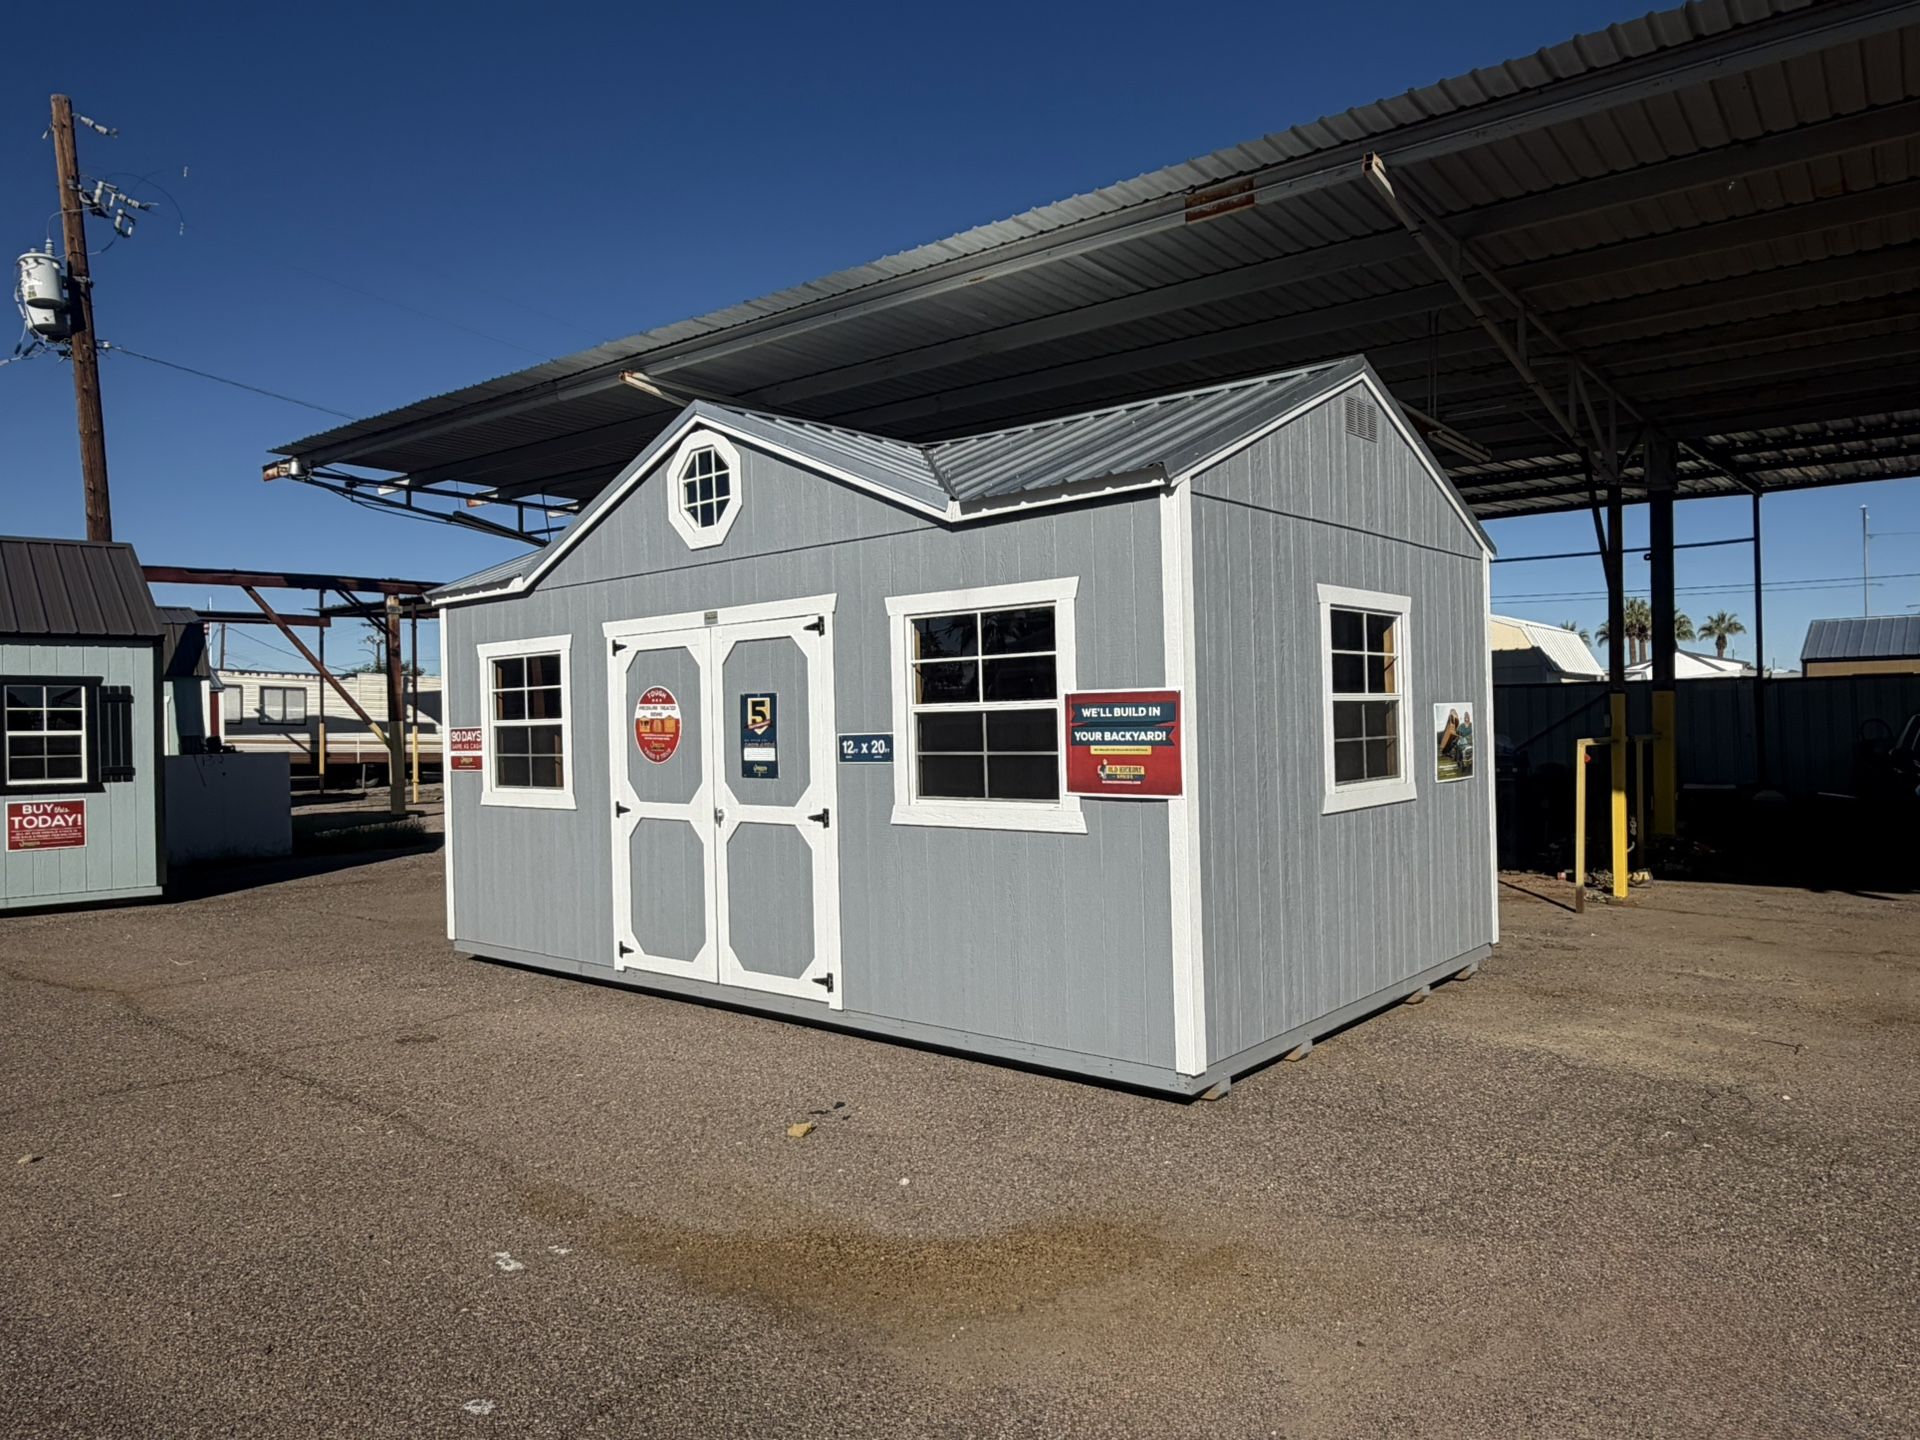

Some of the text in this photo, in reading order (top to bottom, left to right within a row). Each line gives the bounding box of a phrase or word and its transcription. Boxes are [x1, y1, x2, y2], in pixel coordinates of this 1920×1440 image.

[752, 701, 767, 724] 5
[1082, 706, 1160, 717] WE'LL BUILD IN
[451, 730, 481, 742] 90 DAYS
[1074, 731, 1166, 741] YOUR BACKYARD!
[22, 804, 54, 814] BUY
[10, 814, 82, 829] TODAY!
